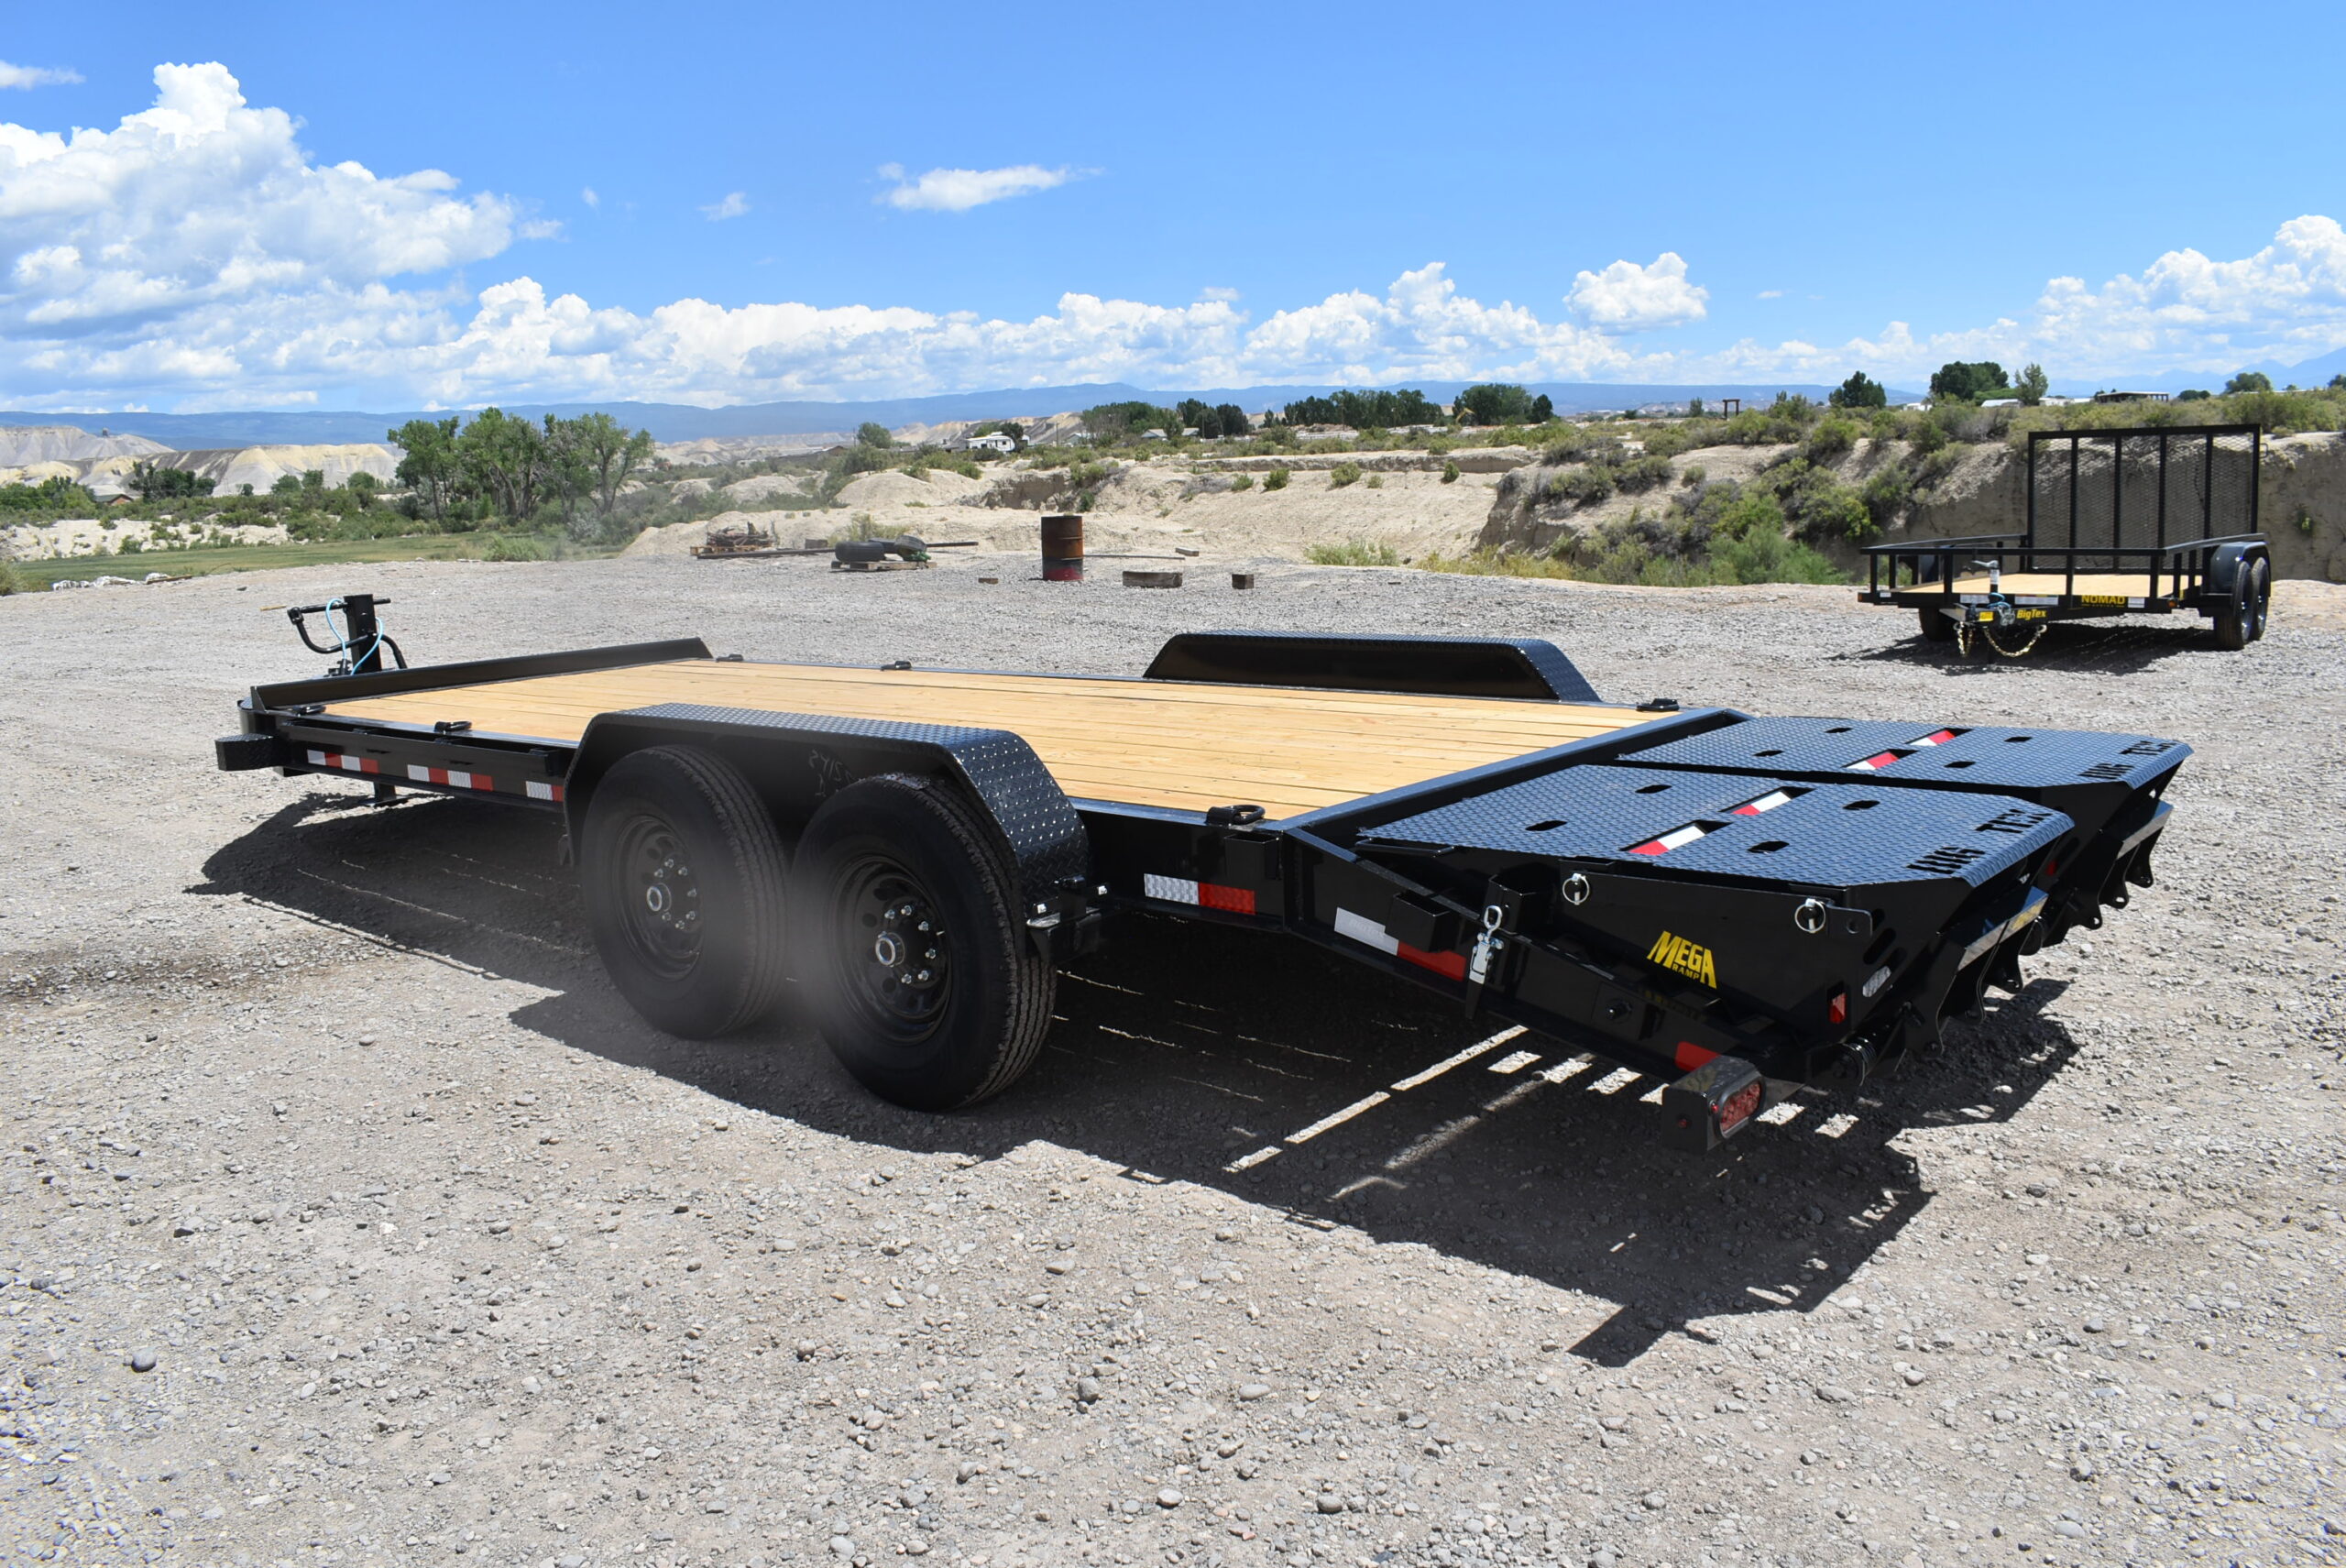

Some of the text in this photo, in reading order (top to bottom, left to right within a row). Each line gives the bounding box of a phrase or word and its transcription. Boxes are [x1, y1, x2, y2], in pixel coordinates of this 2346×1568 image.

[2081, 595, 2125, 605] NOMAD
[2016, 609, 2047, 620] BigTex
[1973, 808, 2054, 834] TEX
[1647, 930, 1717, 990] MEGA
[1672, 963, 1701, 980] RAMP
